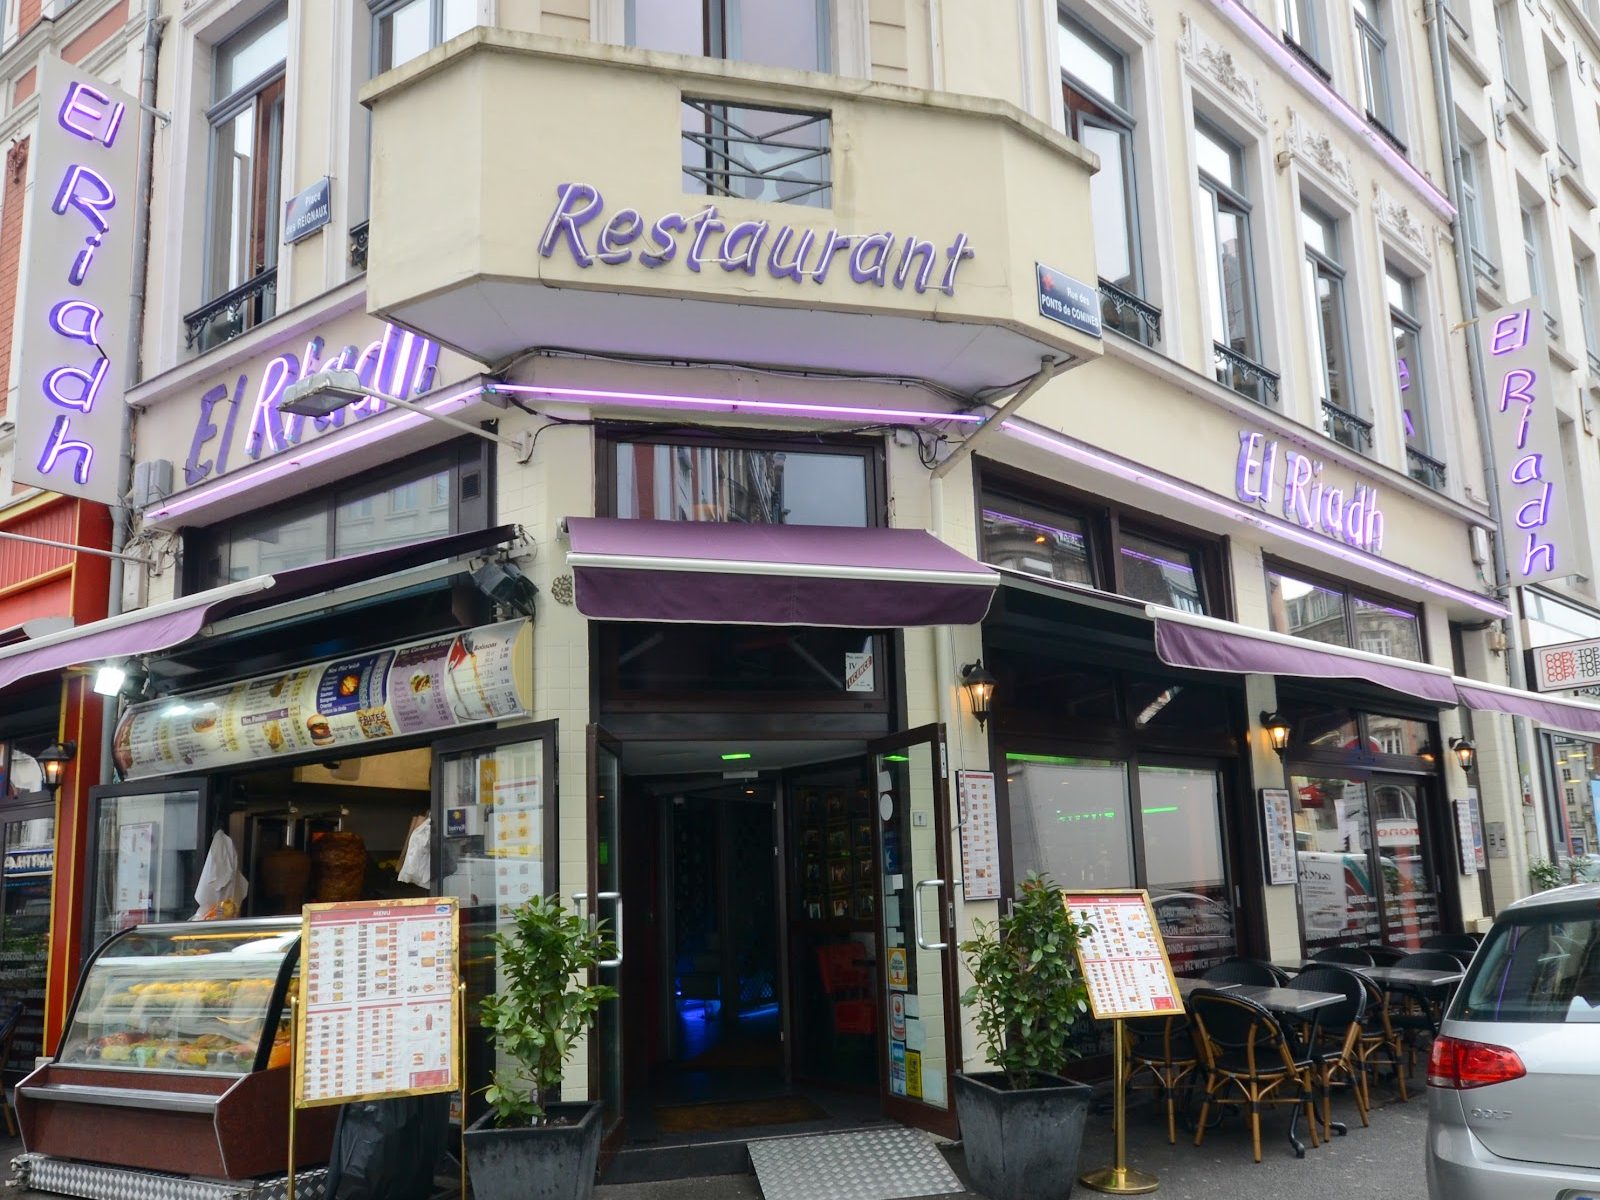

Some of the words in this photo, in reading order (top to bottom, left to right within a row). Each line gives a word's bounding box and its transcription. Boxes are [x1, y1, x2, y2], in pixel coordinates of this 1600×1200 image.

[58, 81, 126, 148] El
[297, 203, 327, 229] REIGNAUX
[540, 182, 974, 296] Restaurant
[37, 164, 116, 485] Riadh
[1041, 294, 1063, 312] PONTS
[1063, 304, 1071, 316] de
[1071, 307, 1099, 328] COMINES
[1067, 287, 1079, 300] Rue
[1079, 293, 1090, 306] des
[1490, 308, 1530, 356] El
[185, 374, 249, 486] El
[1499, 368, 1555, 576] Riadh
[1235, 430, 1277, 504] El
[1283, 450, 1385, 551] Riadh
